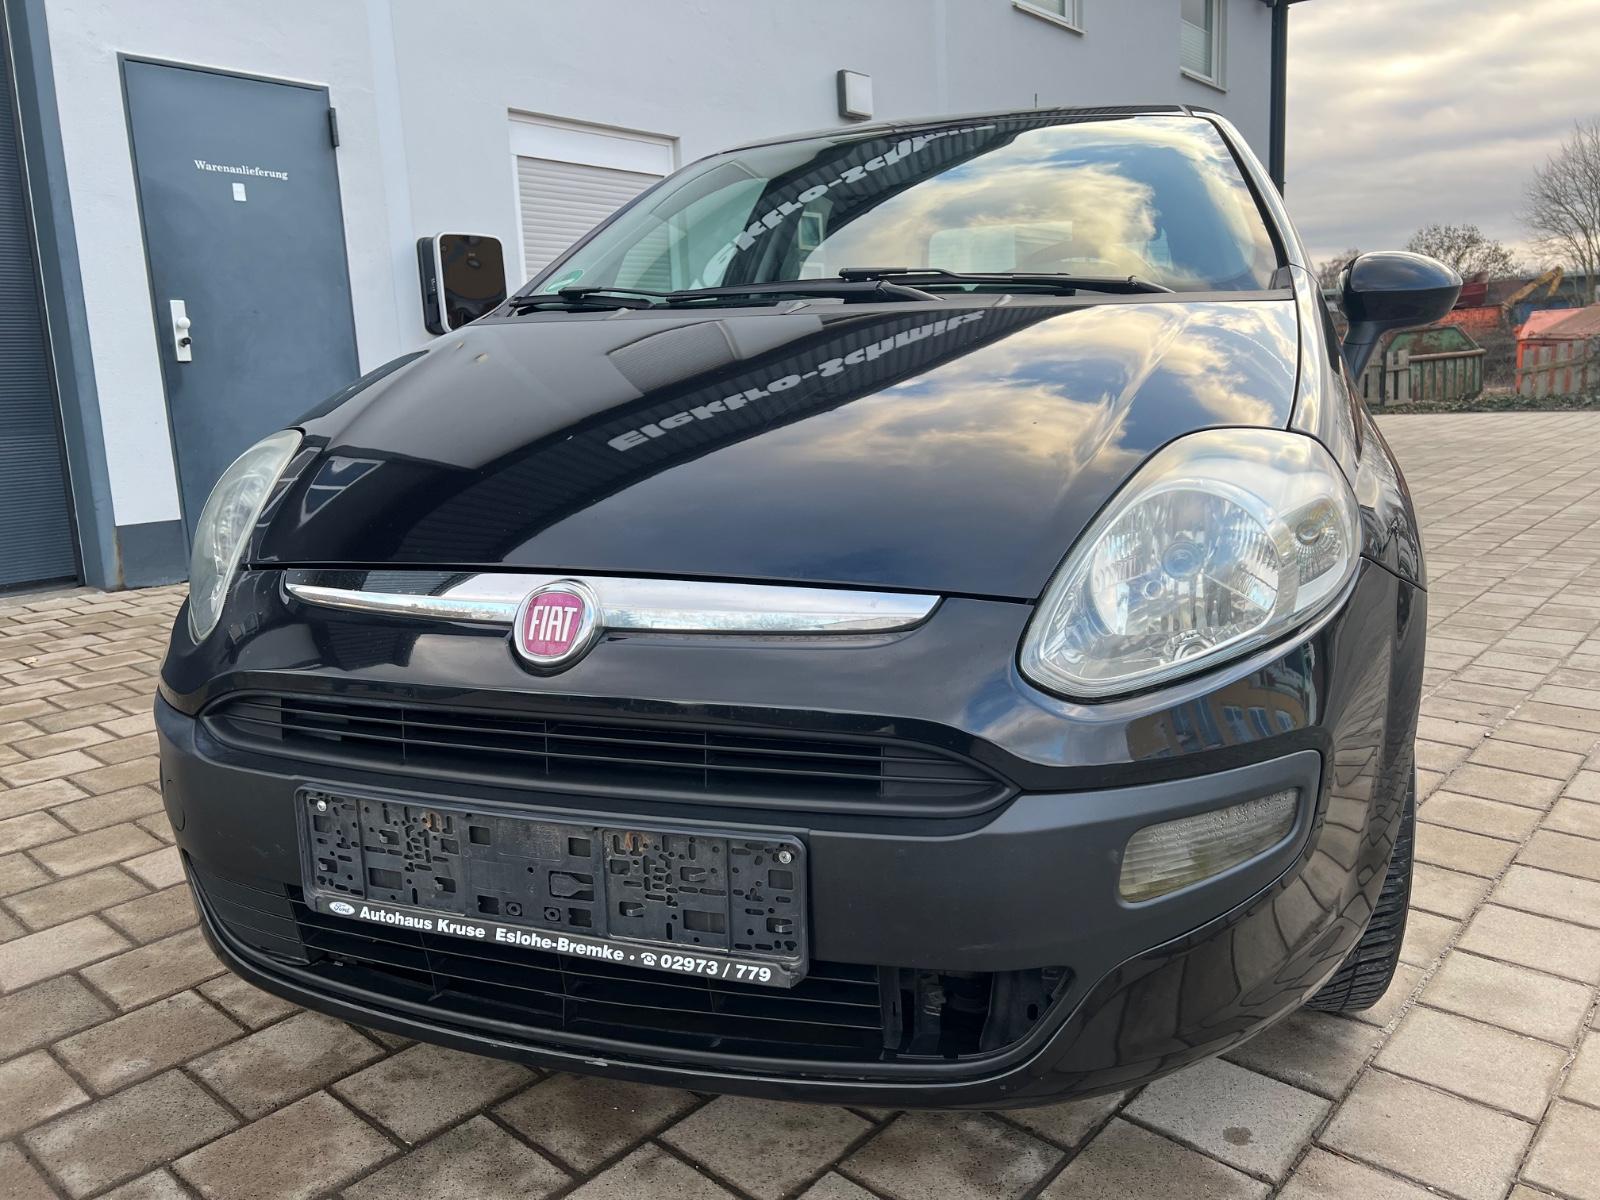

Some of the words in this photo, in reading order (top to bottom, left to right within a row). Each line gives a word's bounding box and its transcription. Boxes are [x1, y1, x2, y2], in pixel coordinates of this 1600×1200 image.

[194, 159, 288, 180] Warenanlieferung
[528, 605, 578, 642] FIAT
[359, 906, 433, 930] Autohaus
[437, 918, 486, 938] Kruse
[495, 927, 625, 961] Eslohe-Bremke
[660, 954, 718, 975] 02973
[735, 964, 772, 982] 779
